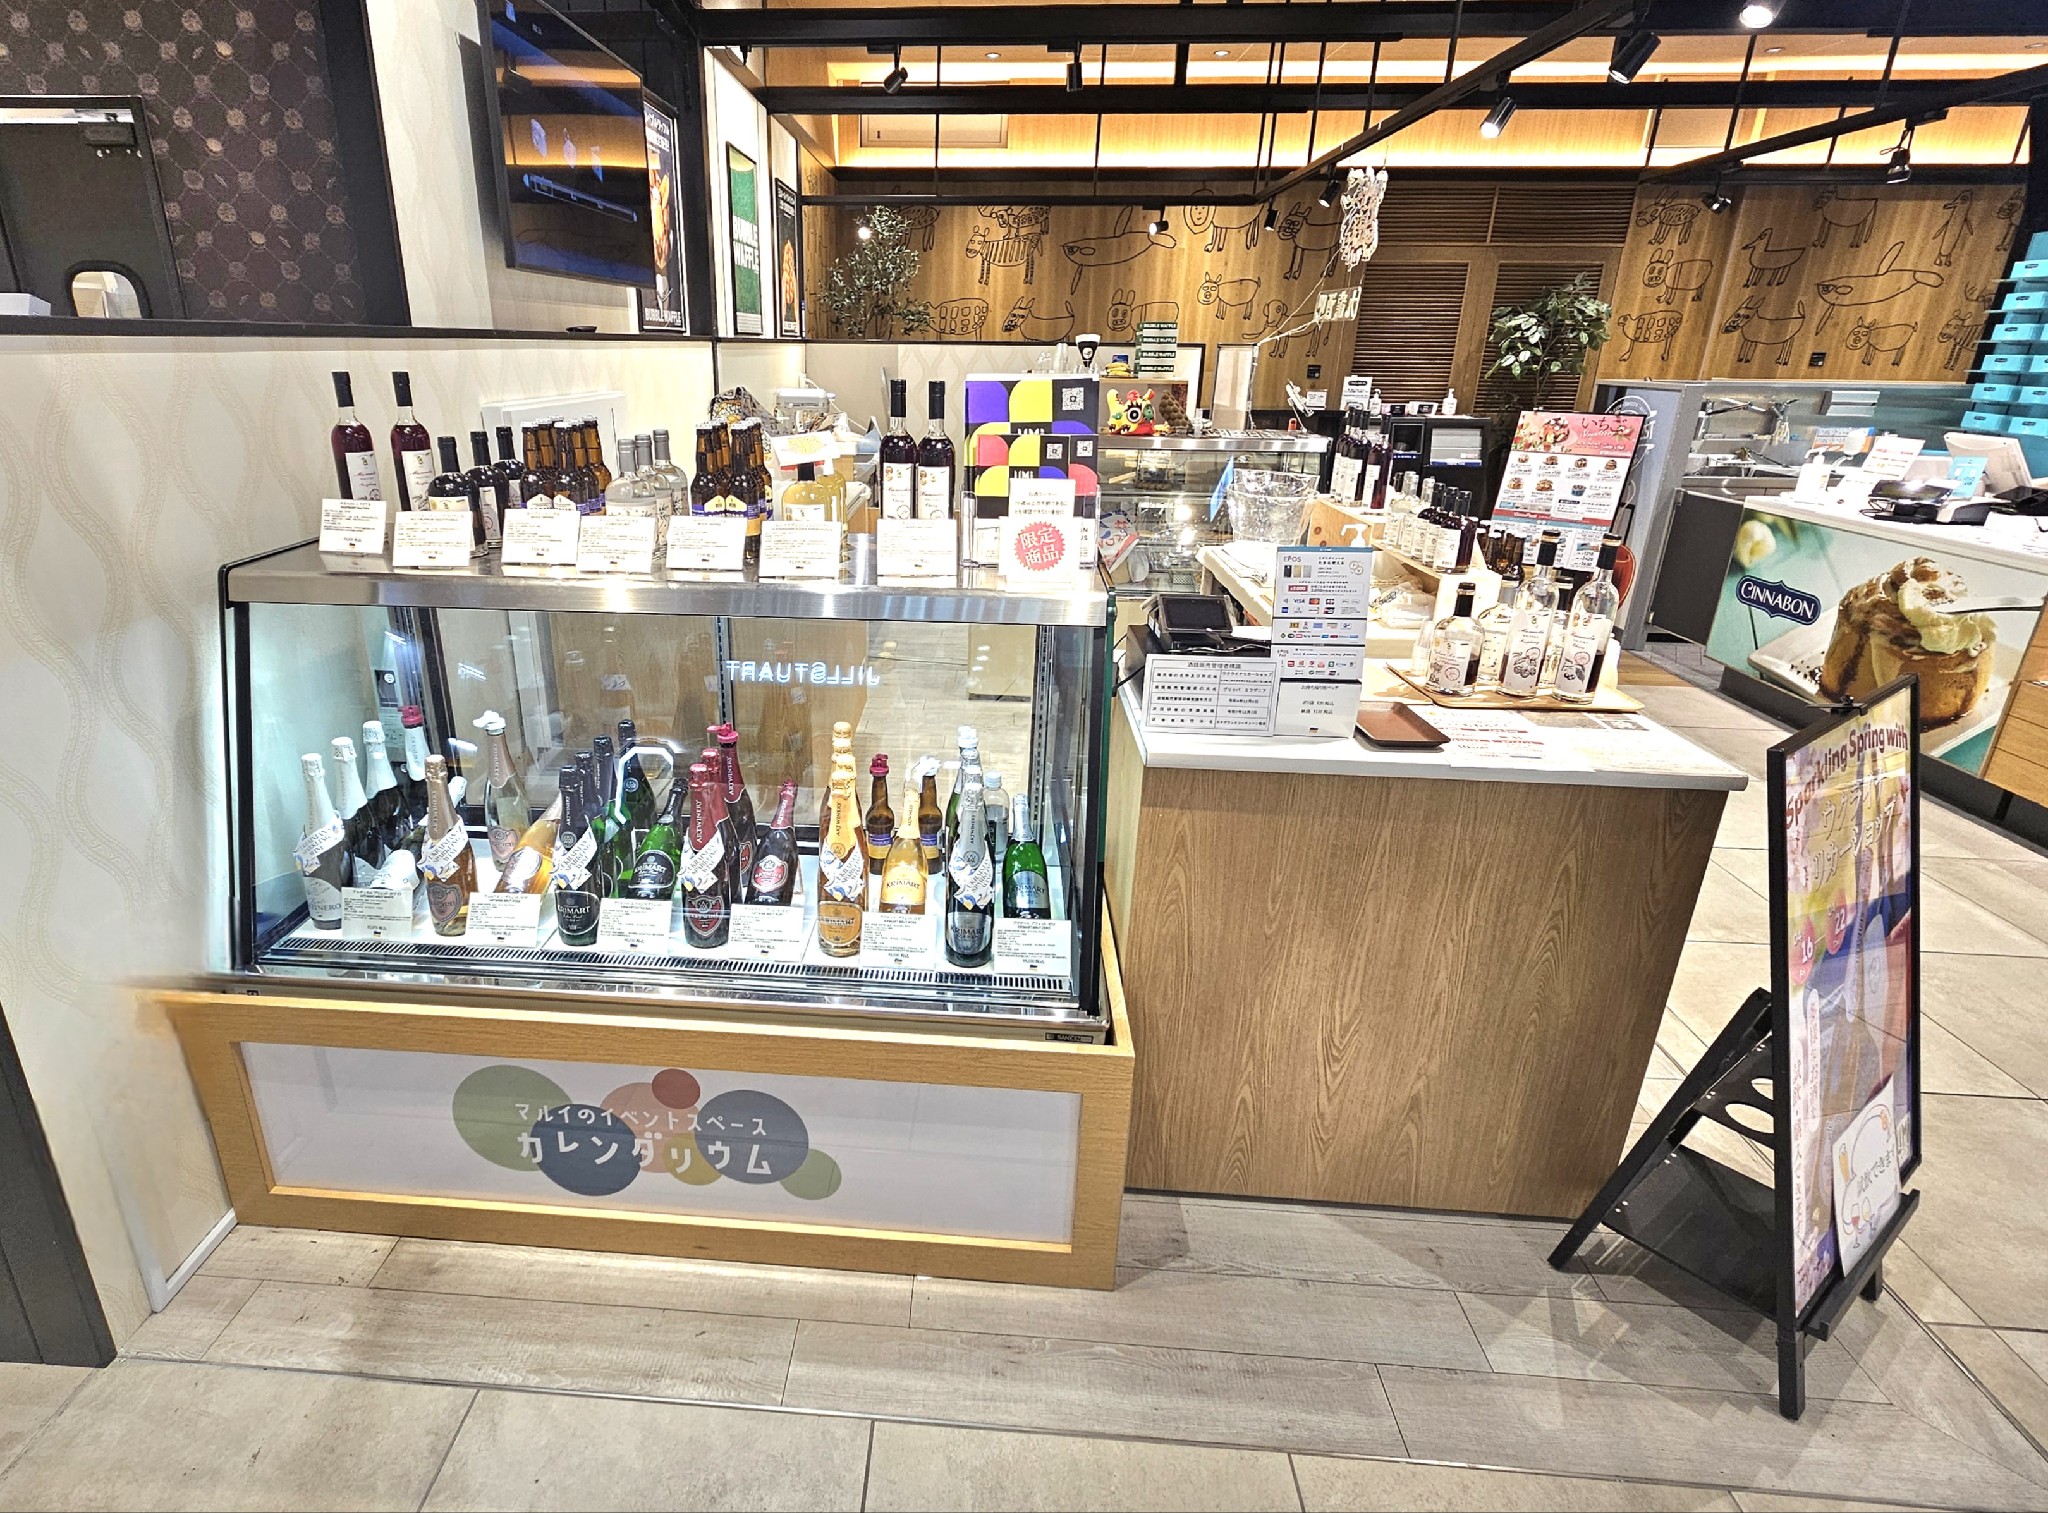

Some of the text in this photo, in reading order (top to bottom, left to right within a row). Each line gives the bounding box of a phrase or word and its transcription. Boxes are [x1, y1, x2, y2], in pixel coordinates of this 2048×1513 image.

[734, 240, 760, 274] WAFFLE
[644, 308, 664, 321] BUBBLE
[1020, 526, 1056, 550] 限定
[1024, 544, 1060, 566] 商品
[1740, 581, 1815, 618] CINNABON
[1786, 722, 1908, 828] Sparkling Spring with
[428, 833, 457, 861] UKRAINIAN
[1812, 794, 1896, 892] リカーショップ
[634, 862, 666, 874] KRIMART
[886, 881, 920, 890] KRIMART
[557, 904, 590, 914] KRIMART
[1835, 908, 1846, 935] 22
[1801, 936, 1814, 964] 16
[515, 1103, 766, 1136] マルイのイベントスペース
[517, 1132, 772, 1175] カレンダリウム
